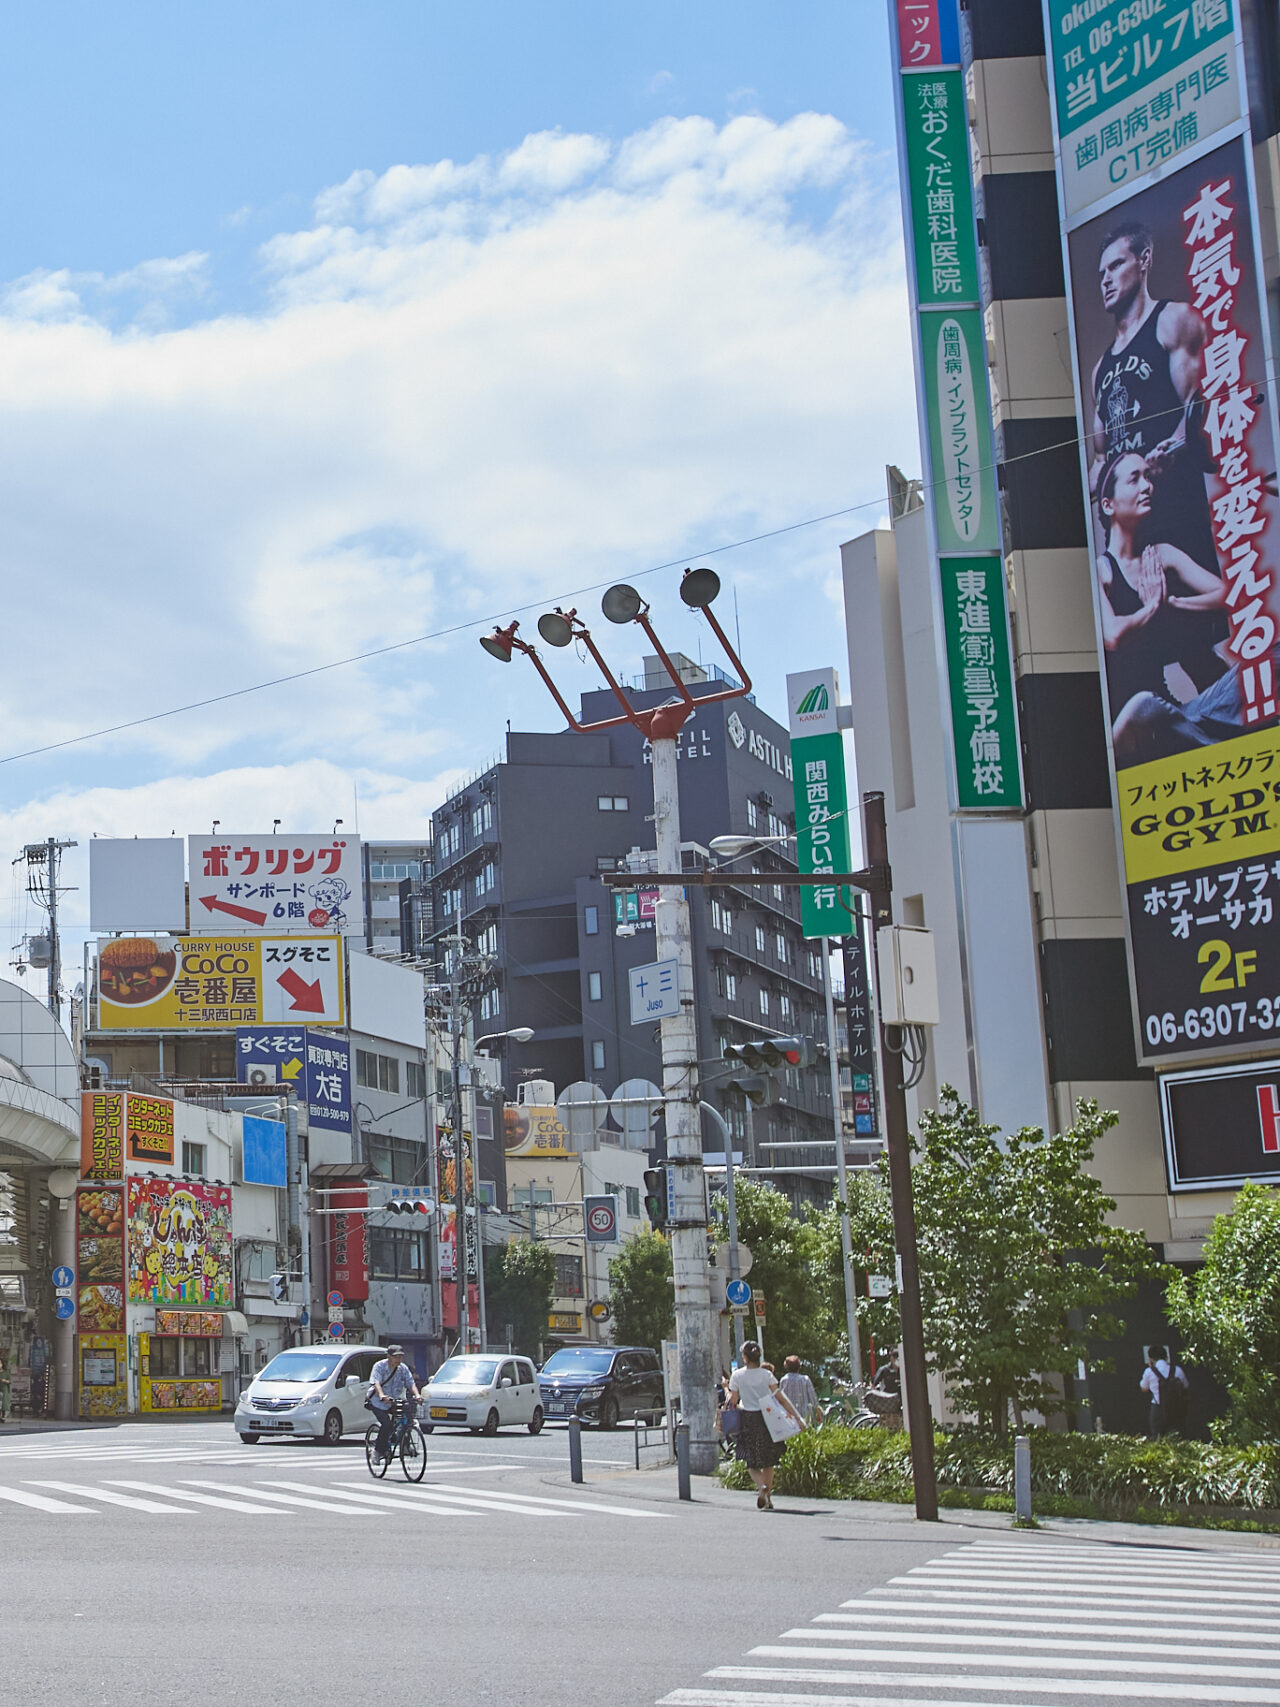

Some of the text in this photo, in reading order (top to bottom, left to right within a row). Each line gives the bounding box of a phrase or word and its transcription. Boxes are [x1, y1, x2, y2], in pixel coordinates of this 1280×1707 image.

[1062, 46, 1085, 72] TEL
[1075, 52, 1230, 171] 歯周病専門医
[1108, 110, 1199, 184] CT完備
[921, 109, 962, 294] おくだ歯科医院
[955, 570, 1005, 797] 東進衛星予備校
[799, 714, 826, 723] KANSAI
[642, 729, 711, 750] ATIL
[643, 745, 711, 765] HTEL
[1128, 750, 1280, 806] フィットネスクラ
[1162, 810, 1272, 852] GYM
[203, 840, 346, 877] ボウリング
[227, 882, 306, 899] サンポード
[272, 901, 305, 919] 6階
[1170, 897, 1272, 939] オーサカ
[173, 942, 256, 953] CURRY HOUSE
[265, 946, 331, 963] スグそこ
[181, 953, 249, 975] CoCo
[1197, 939, 1257, 994] 2F
[173, 977, 257, 1005] 壱番屋
[636, 969, 673, 998] 十三
[173, 1007, 257, 1022] 十三駅西口店
[646, 999, 664, 1012] Juso
[238, 1036, 304, 1053] すぐそこ
[308, 1044, 349, 1071] 買取専門店
[316, 1071, 343, 1103] 大吉
[127, 1097, 174, 1119] インターネット
[93, 1094, 107, 1170] コミックカフェ
[107, 1093, 122, 1170] インターネット
[127, 1115, 174, 1136] コミックカフェ
[593, 1213, 609, 1226] 50
